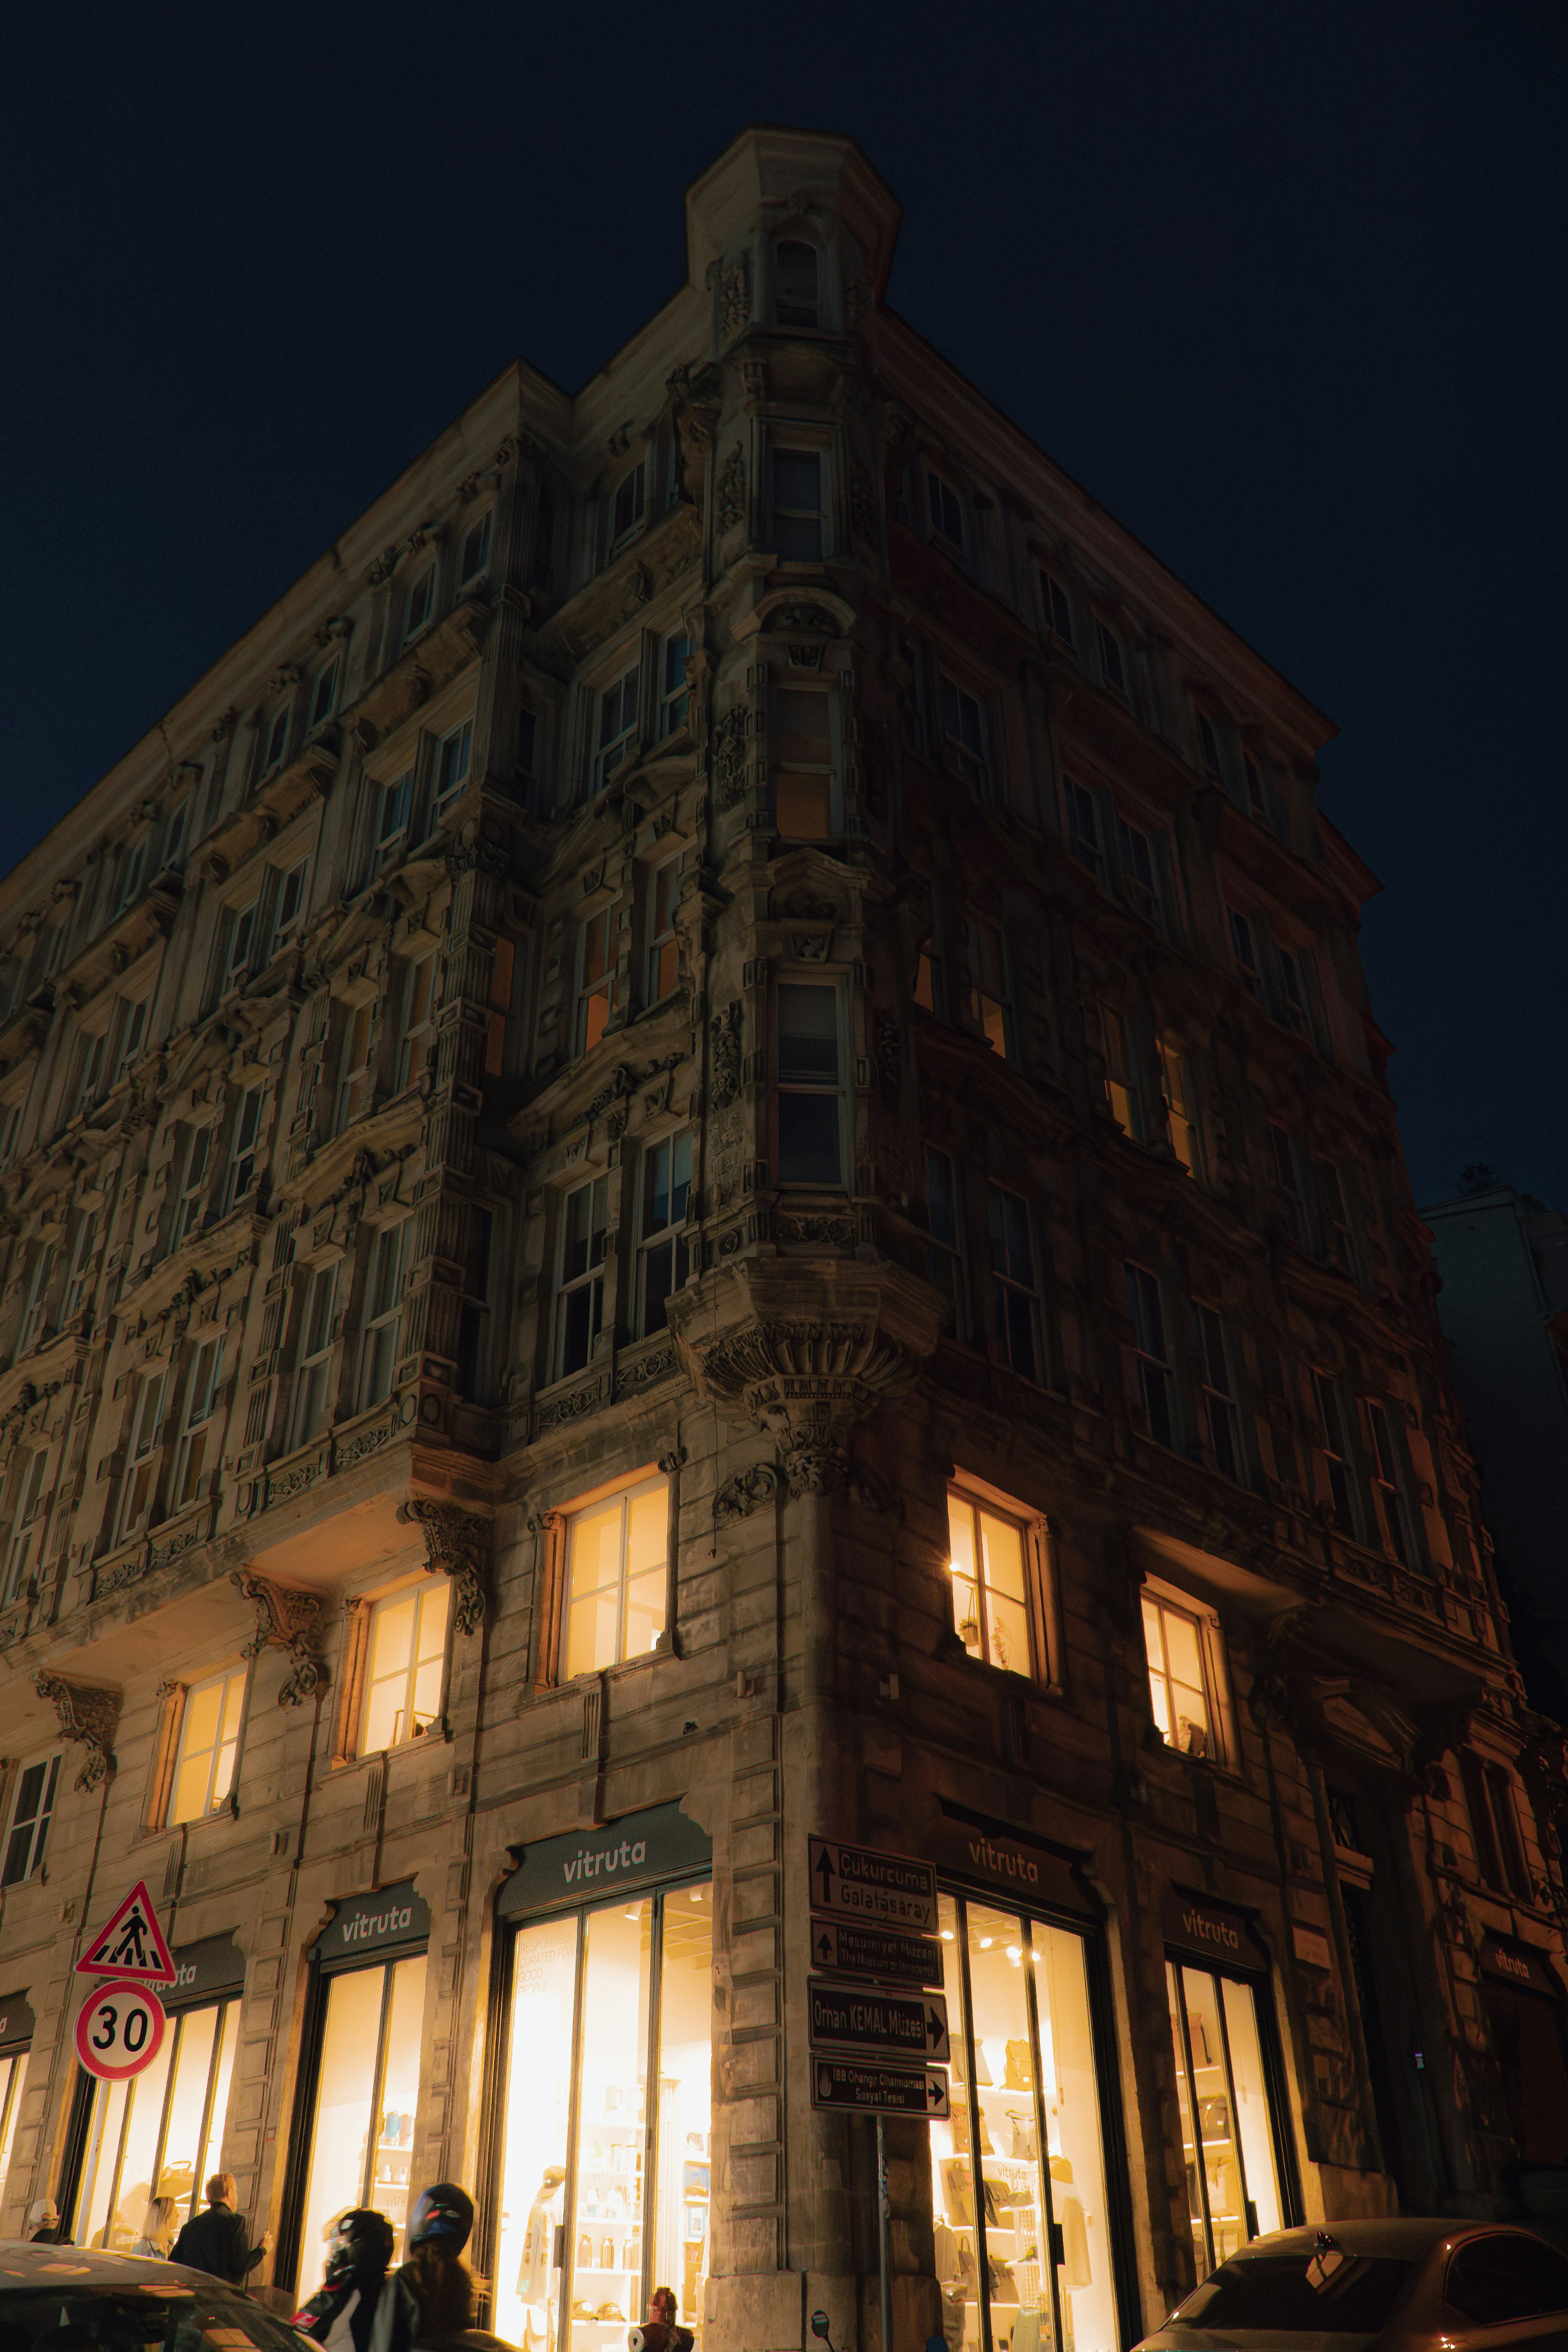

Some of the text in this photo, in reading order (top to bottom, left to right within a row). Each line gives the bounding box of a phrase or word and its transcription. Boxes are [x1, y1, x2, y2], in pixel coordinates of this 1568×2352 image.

[563, 1841, 646, 1883] vitruta
[841, 1852, 928, 1891] Çukurcuma
[969, 1837, 1038, 1883] vitruta
[842, 1884, 930, 1924] Galatasaray
[343, 1906, 411, 1942] vitruta
[1182, 1908, 1239, 1950] vitruta
[520, 1946, 574, 1968] CURATED FOR
[521, 1932, 573, 1954] RESPONSIBLY
[519, 1968, 543, 1983] GOOD
[1494, 1948, 1529, 1979] vitruta
[518, 1981, 548, 1996] PEOPLE
[93, 2005, 148, 2052] 30
[814, 1999, 924, 2039] Orhan KEMAL Müzesi
[855, 2088, 881, 2104] Sosyal
[593, 2167, 627, 2181] vitruta
[998, 2164, 1026, 2180] vitruta
